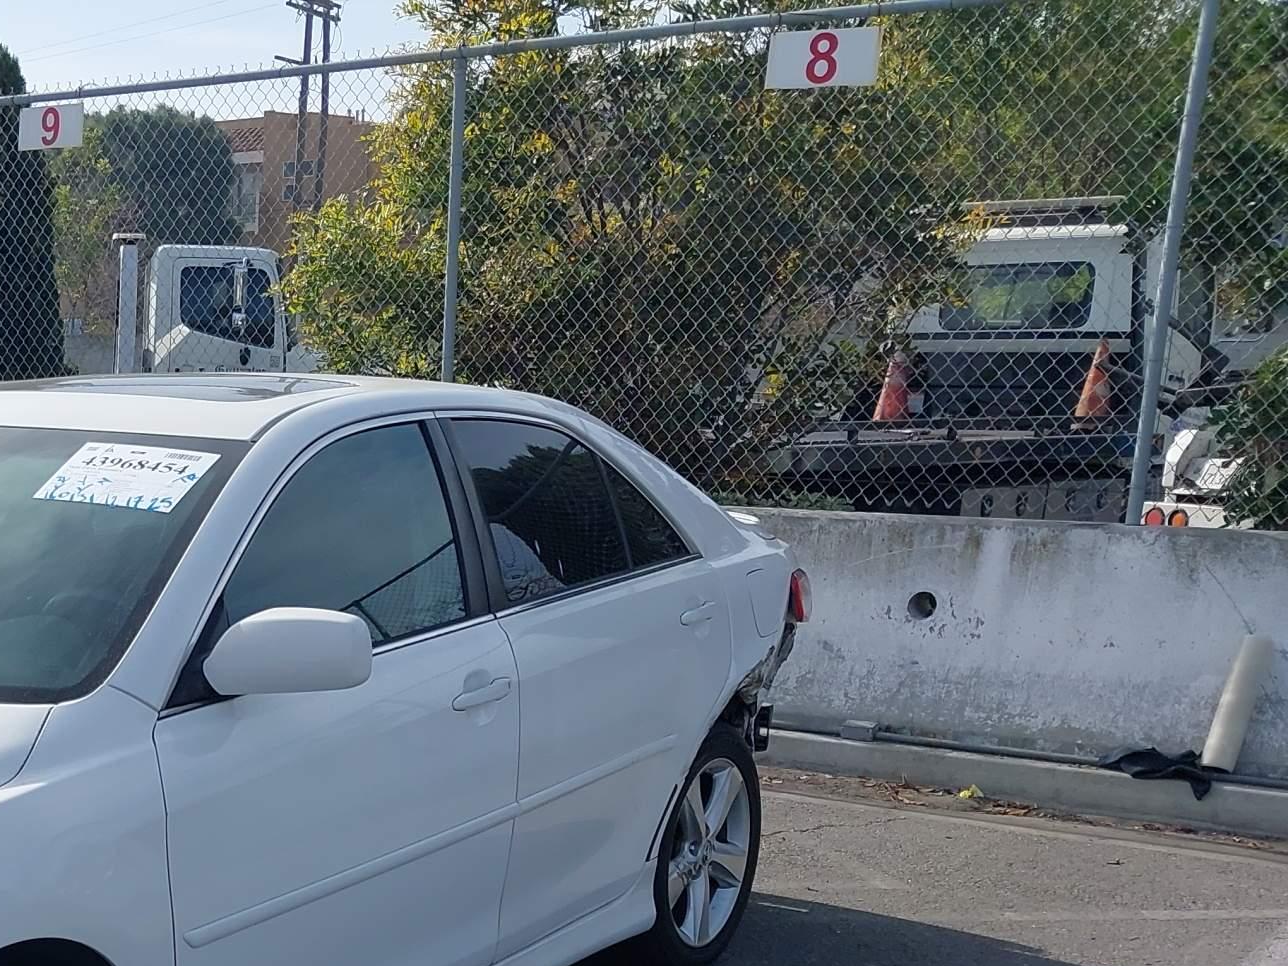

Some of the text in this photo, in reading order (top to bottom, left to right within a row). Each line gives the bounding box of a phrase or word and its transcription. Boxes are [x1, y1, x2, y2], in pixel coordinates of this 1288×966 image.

[806, 32, 838, 84] 8
[41, 107, 60, 146] 9
[81, 455, 190, 475] 43968454
